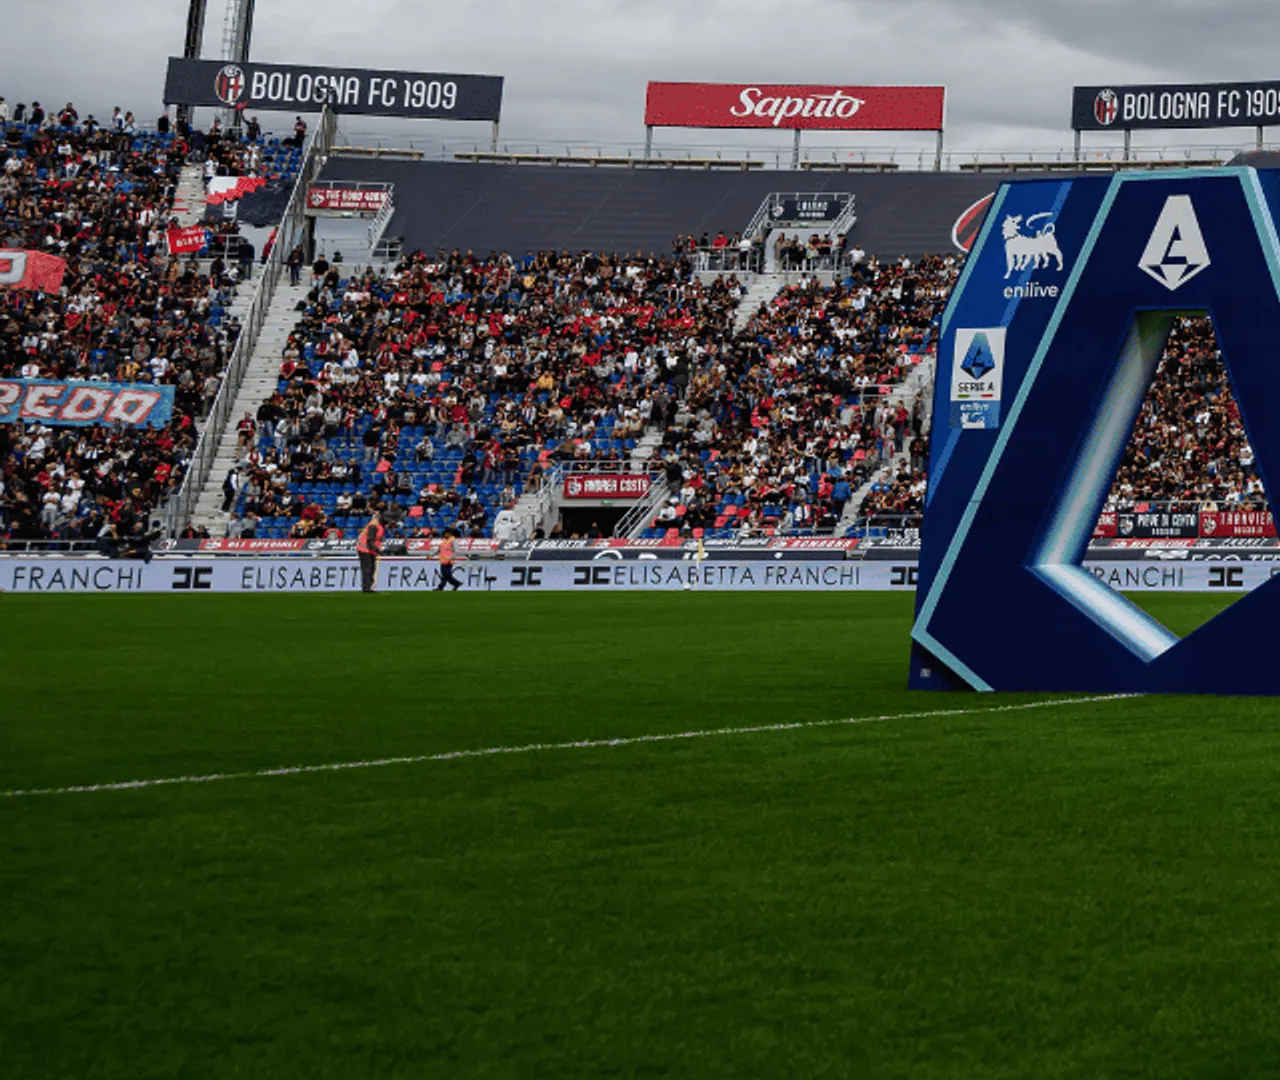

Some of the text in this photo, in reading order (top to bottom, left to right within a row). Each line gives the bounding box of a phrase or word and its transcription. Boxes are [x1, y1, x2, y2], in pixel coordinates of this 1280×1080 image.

[251, 71, 458, 110] BOLOGNA FC 1909
[729, 87, 866, 127] Saputo
[1123, 90, 1210, 121] BOLOGNA
[1217, 90, 1241, 119] FC
[1003, 281, 1059, 299] enilive
[1219, 512, 1273, 526] TRANVIER
[12, 566, 144, 590] FRANCHI
[241, 565, 361, 589] ELISABETT
[614, 565, 860, 585] ELISABETTA FRANCHI
